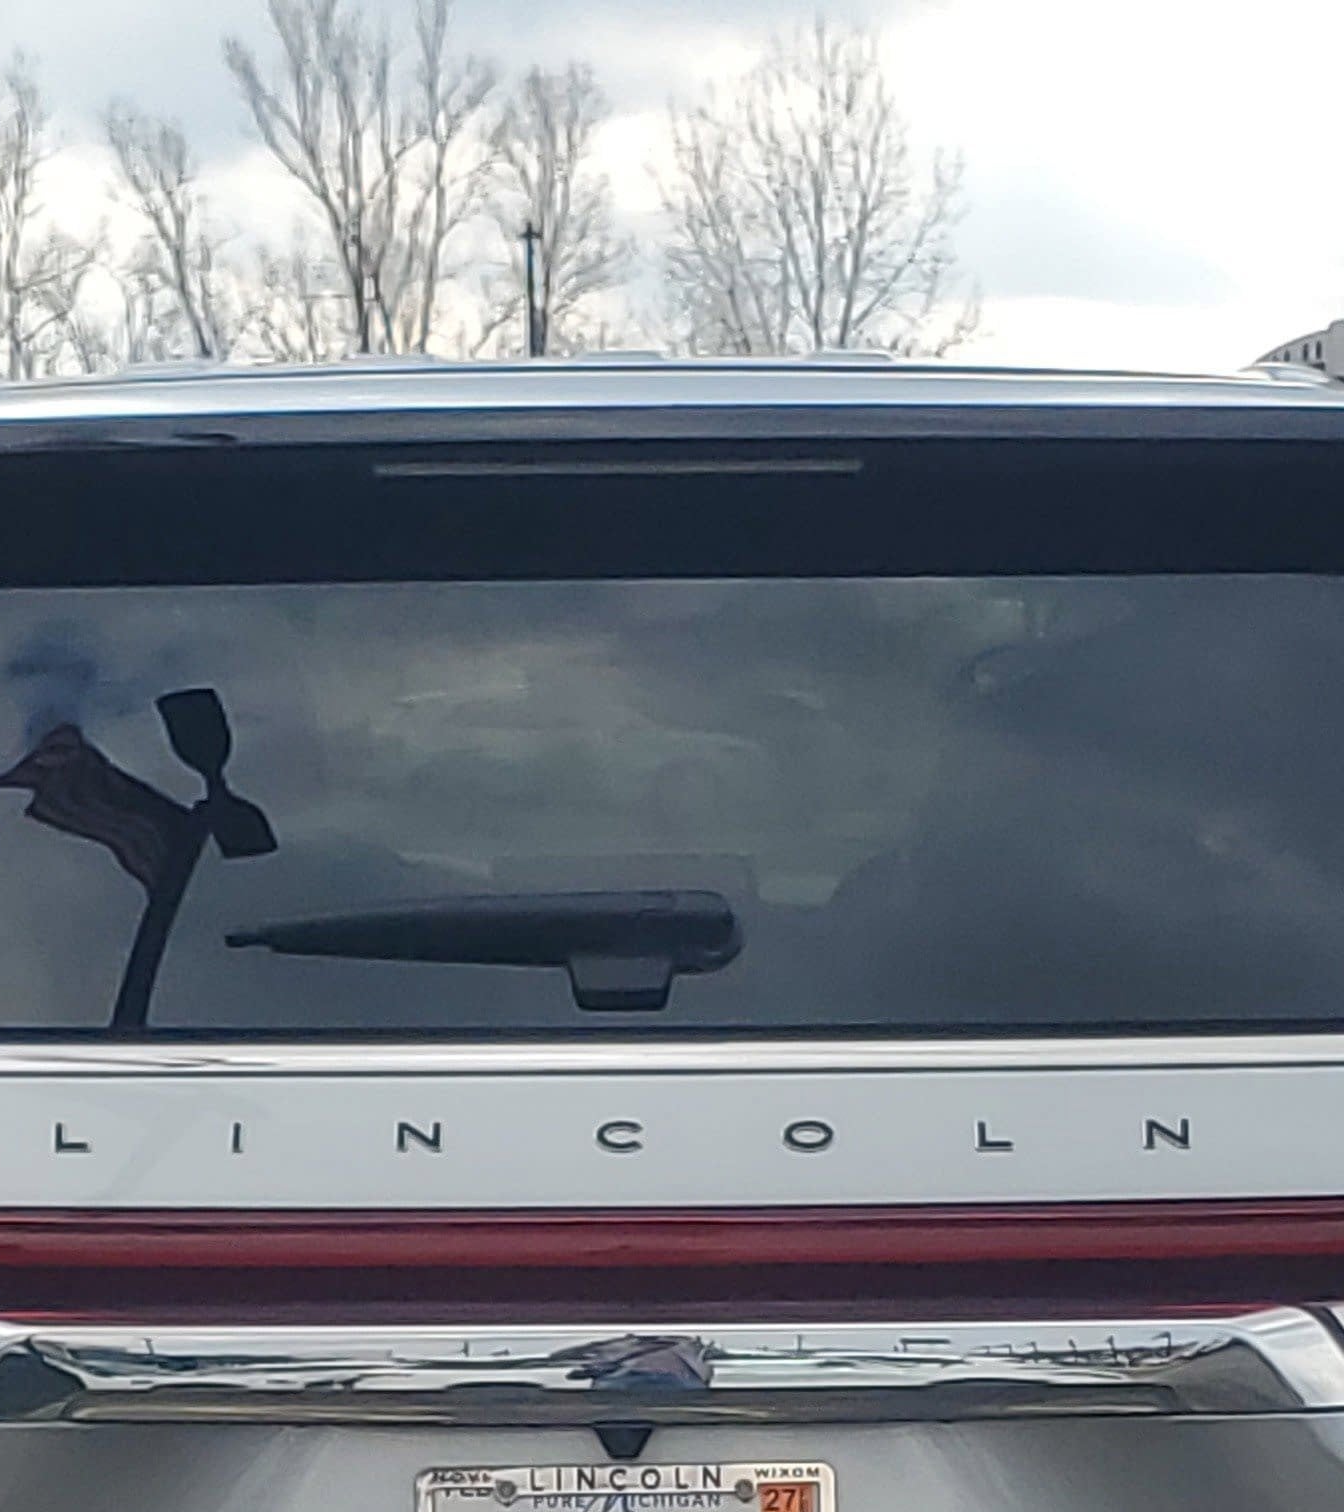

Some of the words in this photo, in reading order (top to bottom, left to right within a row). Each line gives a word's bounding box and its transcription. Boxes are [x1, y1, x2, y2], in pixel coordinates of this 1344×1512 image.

[55, 1117, 1191, 1154] LINCOLN
[530, 1466, 721, 1492] LINCOLN
[755, 1467, 820, 1478] WIXOM
[533, 1495, 586, 1510] PURE
[764, 1488, 797, 1512] 27
